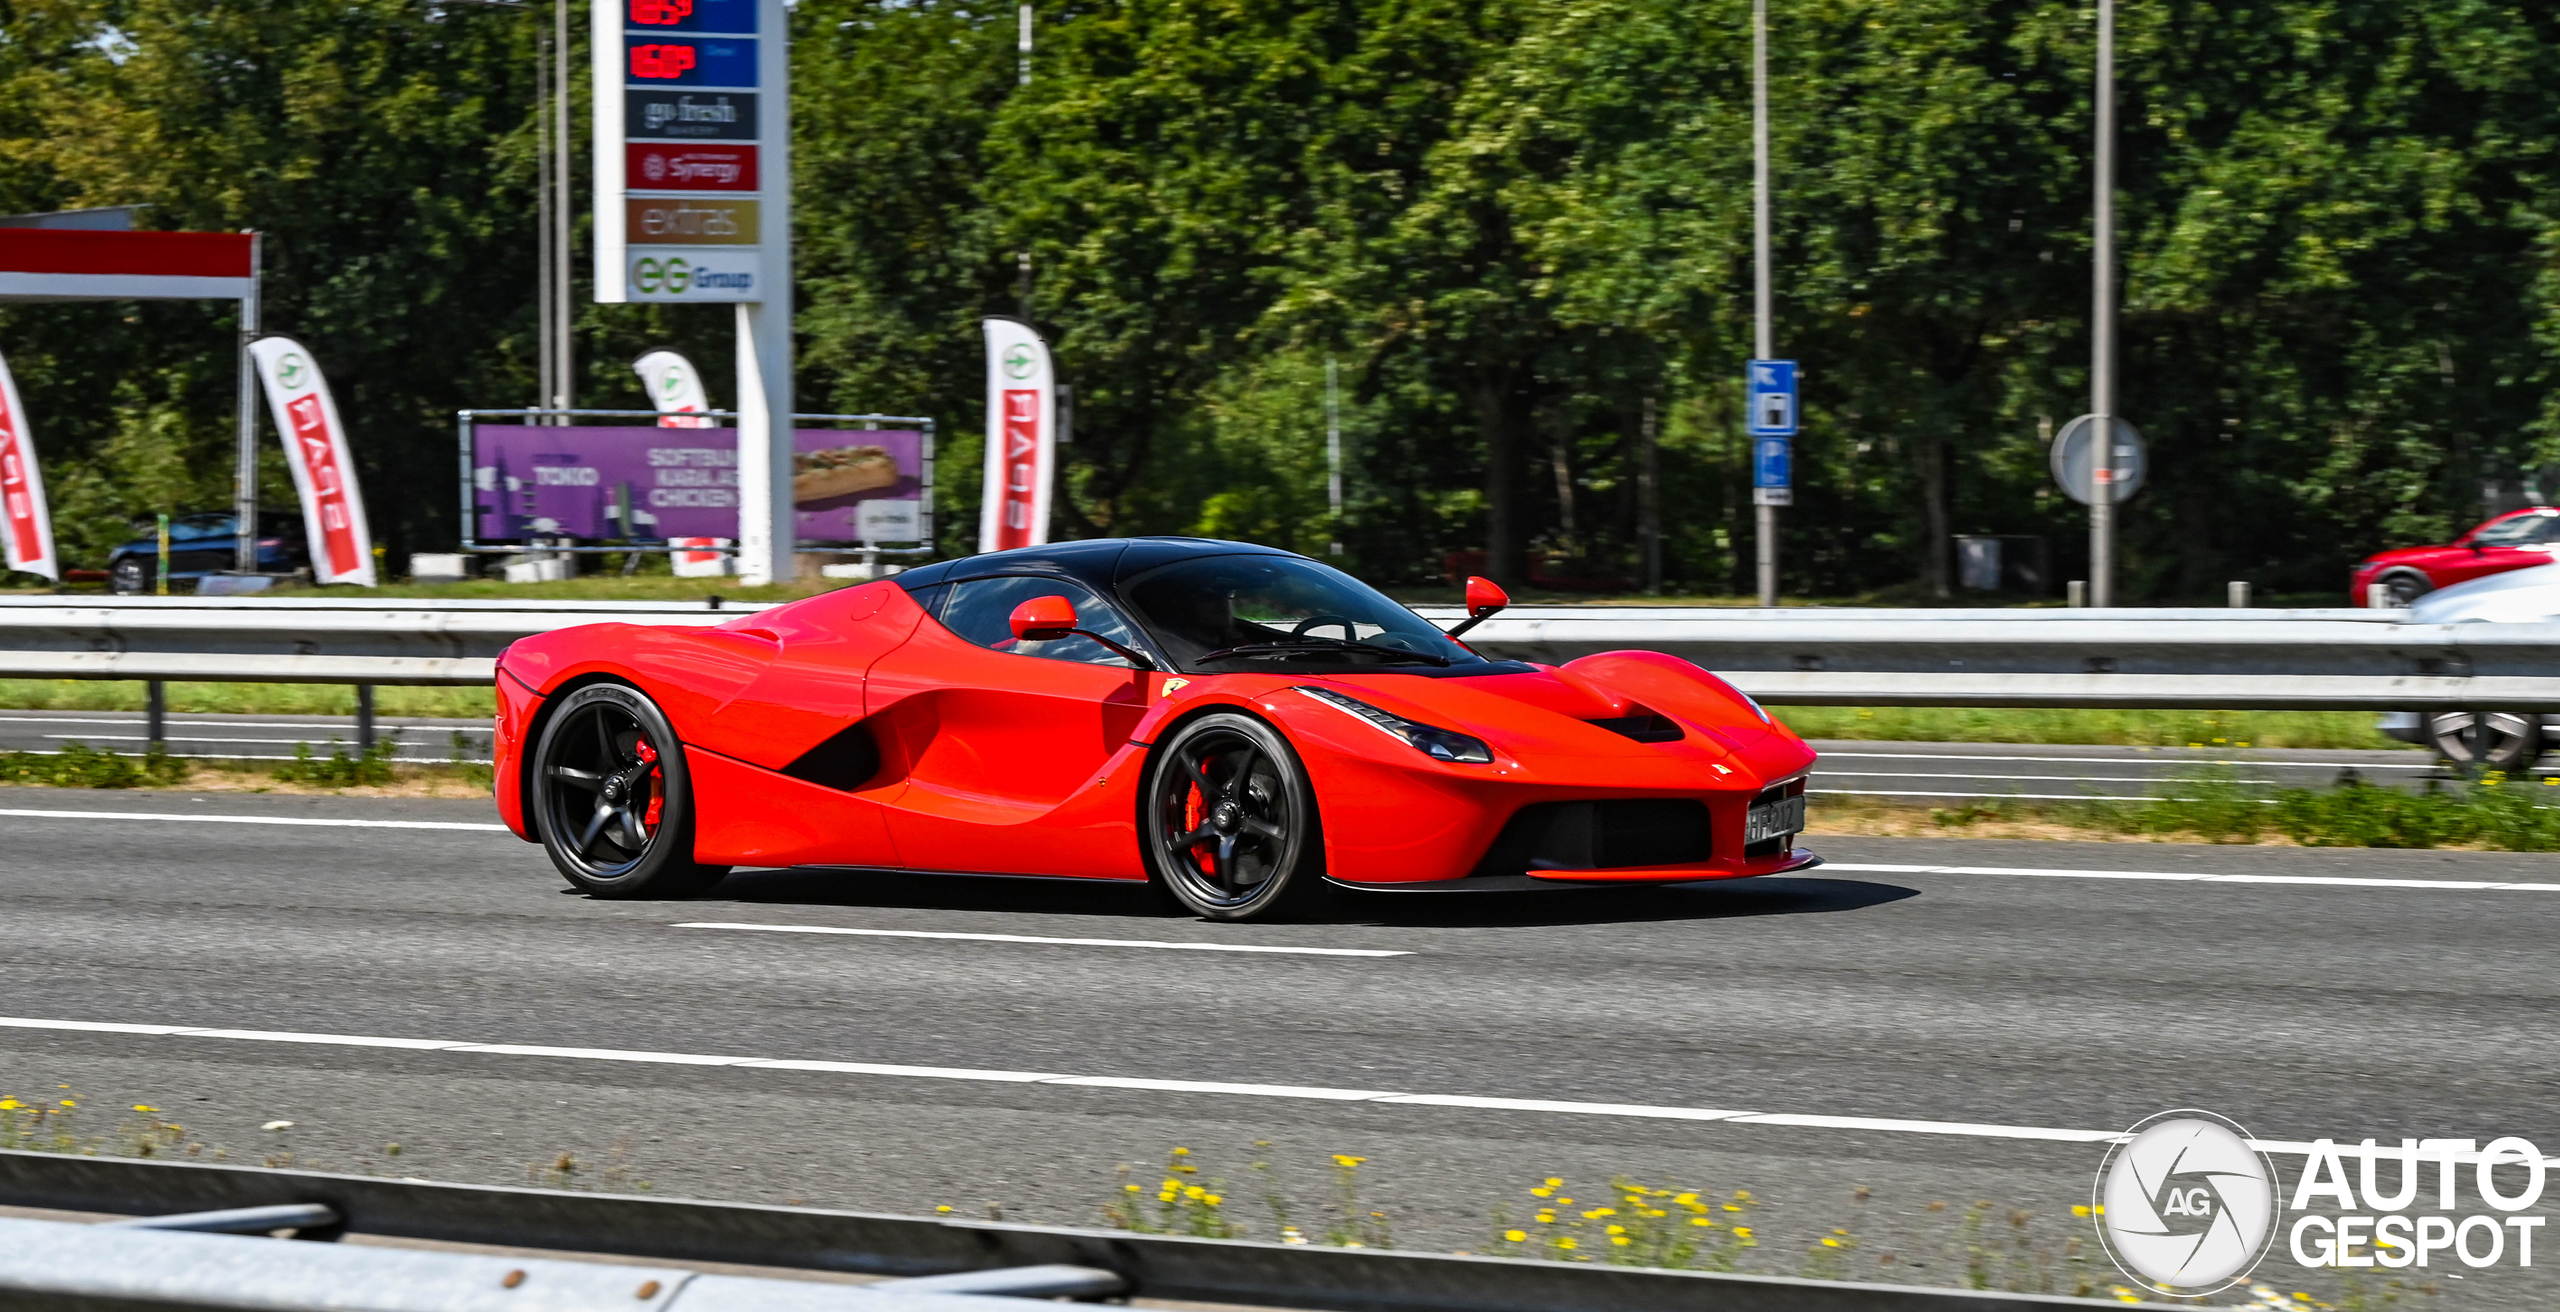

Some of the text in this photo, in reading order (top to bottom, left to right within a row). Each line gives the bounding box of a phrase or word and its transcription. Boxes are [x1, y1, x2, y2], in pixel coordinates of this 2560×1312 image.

[643, 96, 737, 129] go fresh
[668, 157, 742, 183] Synergy
[641, 203, 739, 235] extras
[693, 266, 754, 293] Group
